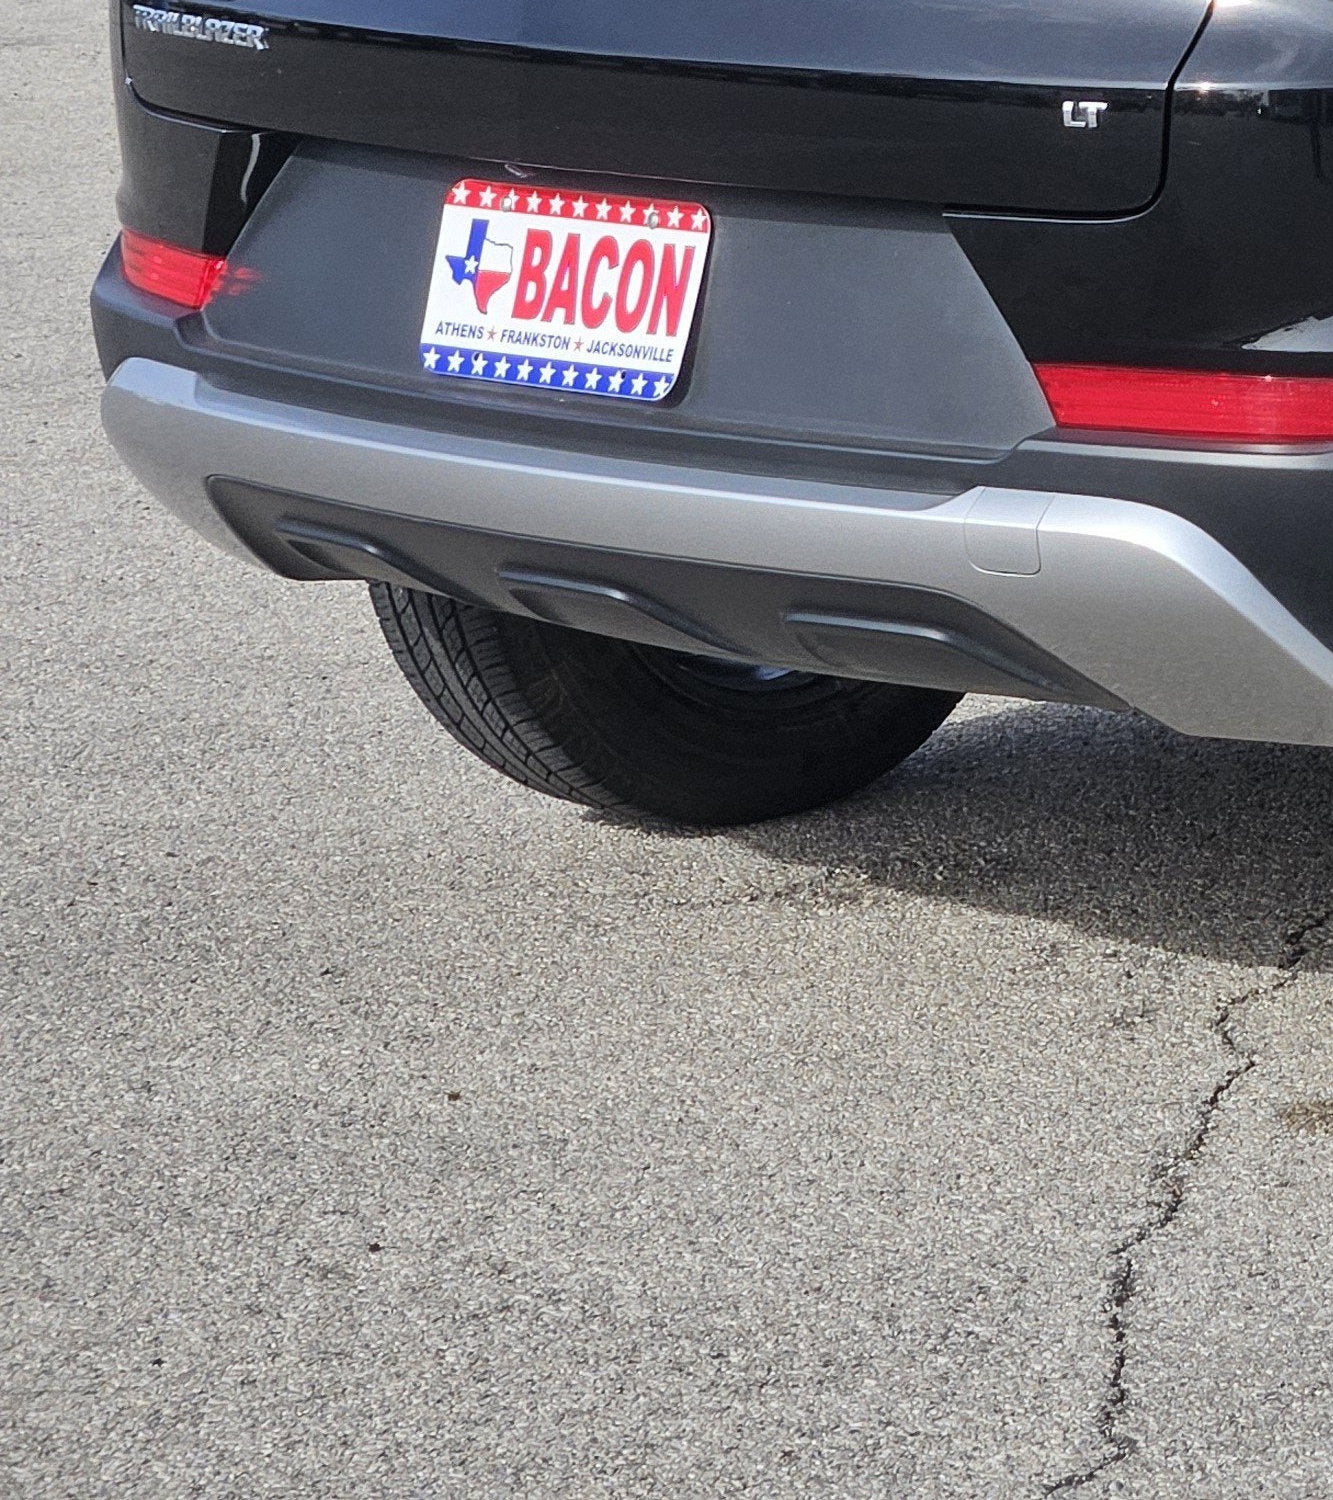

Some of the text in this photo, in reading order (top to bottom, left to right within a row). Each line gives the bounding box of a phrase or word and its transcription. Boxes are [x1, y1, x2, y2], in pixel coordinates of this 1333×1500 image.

[132, 3, 270, 51] TRAILBLAZER
[1062, 100, 1109, 128] LT
[511, 227, 696, 338] BACON
[435, 320, 675, 364] ATHENS FRANKSTON JACKSONVILLE
